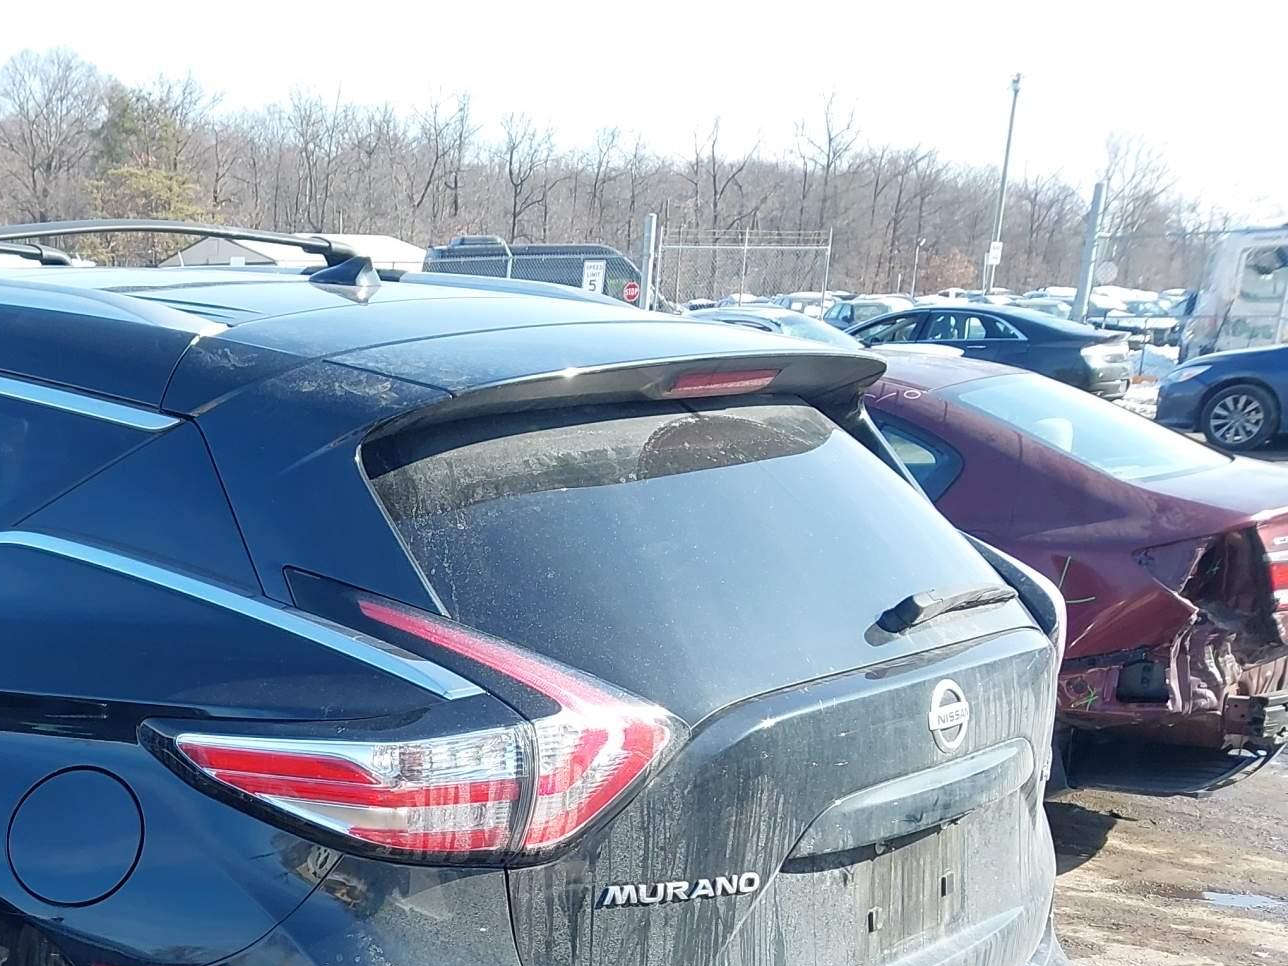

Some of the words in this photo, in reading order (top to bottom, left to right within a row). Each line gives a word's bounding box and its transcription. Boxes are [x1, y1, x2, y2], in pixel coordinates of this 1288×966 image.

[588, 279, 597, 292] 5
[624, 287, 638, 296] STOP
[937, 706, 969, 726] NISSAN
[600, 871, 760, 907] MURANO
